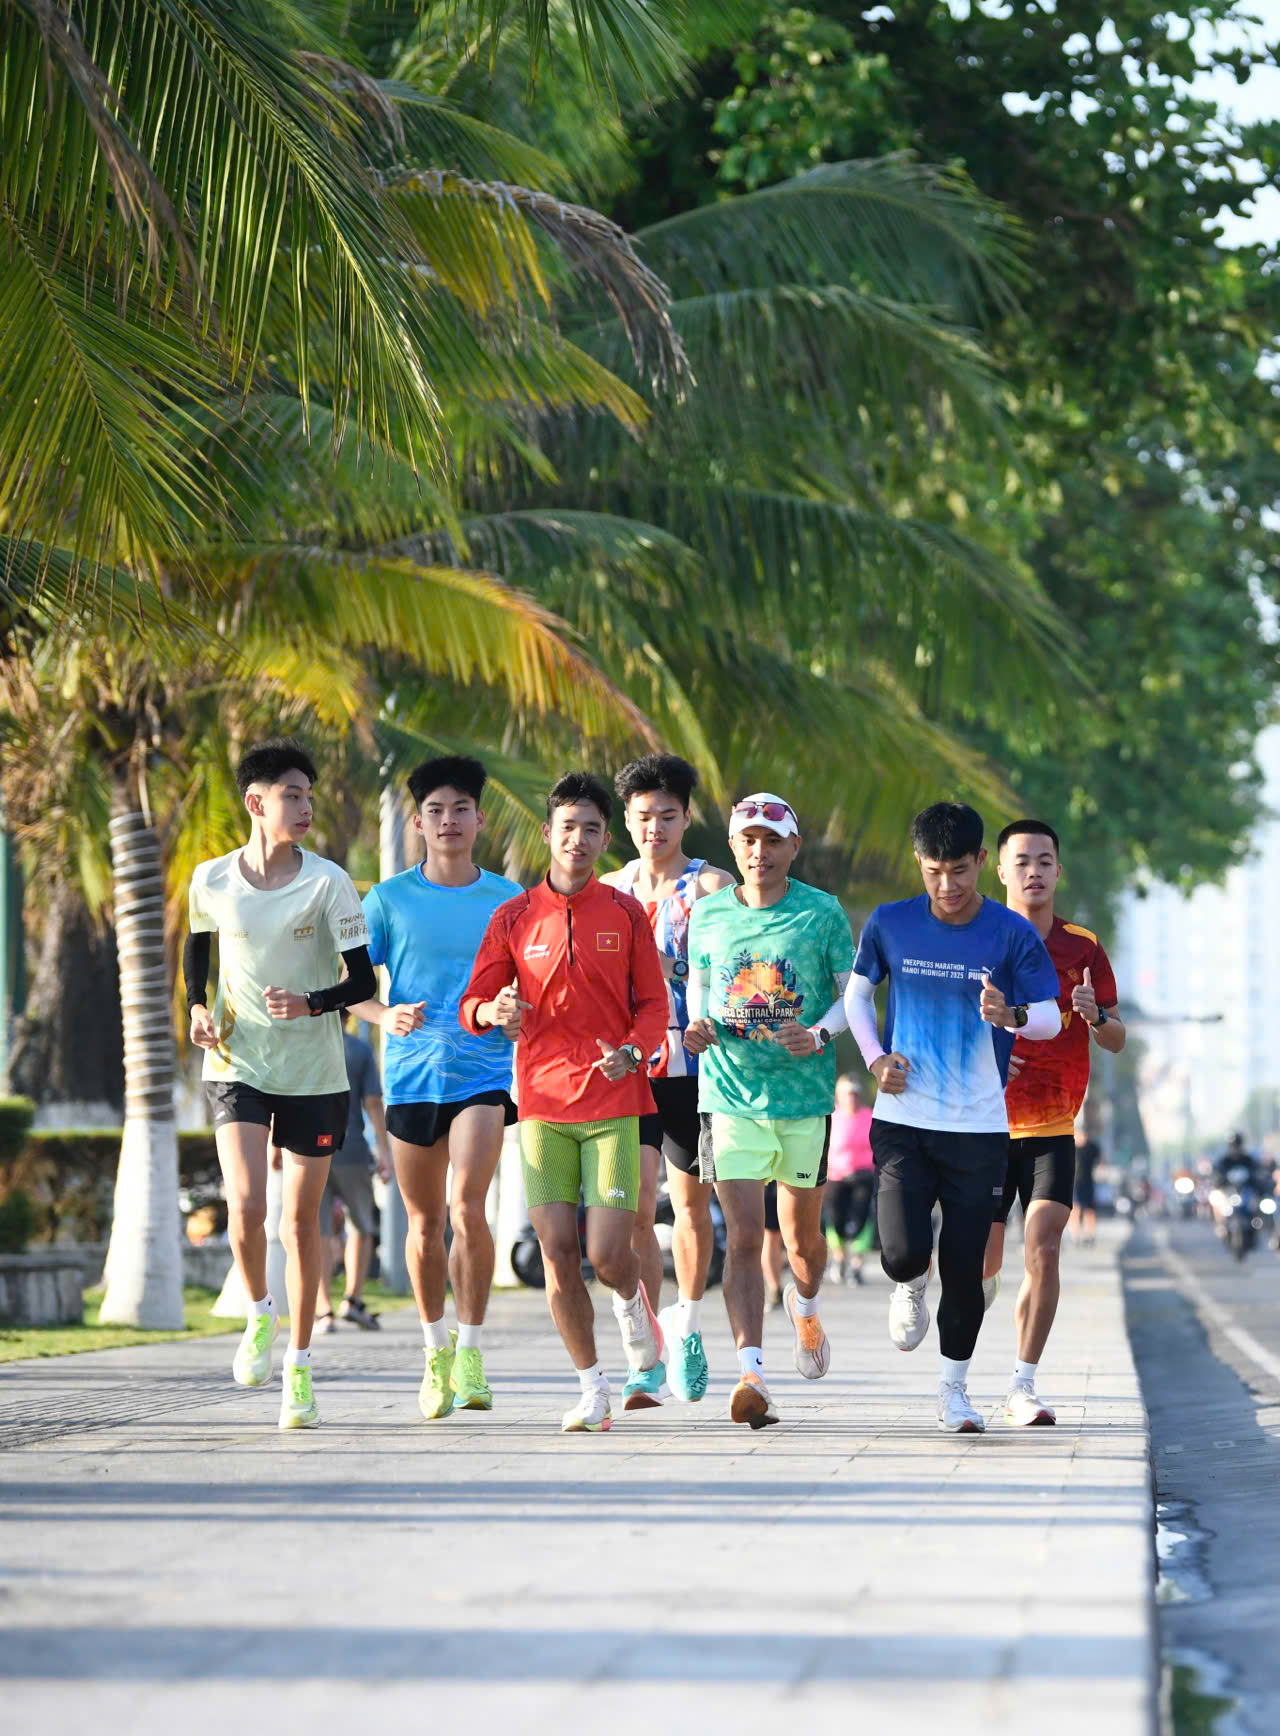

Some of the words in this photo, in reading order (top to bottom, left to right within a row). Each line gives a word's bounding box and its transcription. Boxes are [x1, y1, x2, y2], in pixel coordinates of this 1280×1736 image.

[902, 958, 934, 968] VNEXPRESS
[935, 962, 965, 971] MARATHON
[902, 966, 920, 975] HANOI
[921, 968, 949, 978] MIDNIGHT
[950, 971, 964, 979] 2025
[736, 1008, 770, 1018] CENTRAL
[775, 1008, 795, 1017] PARK
